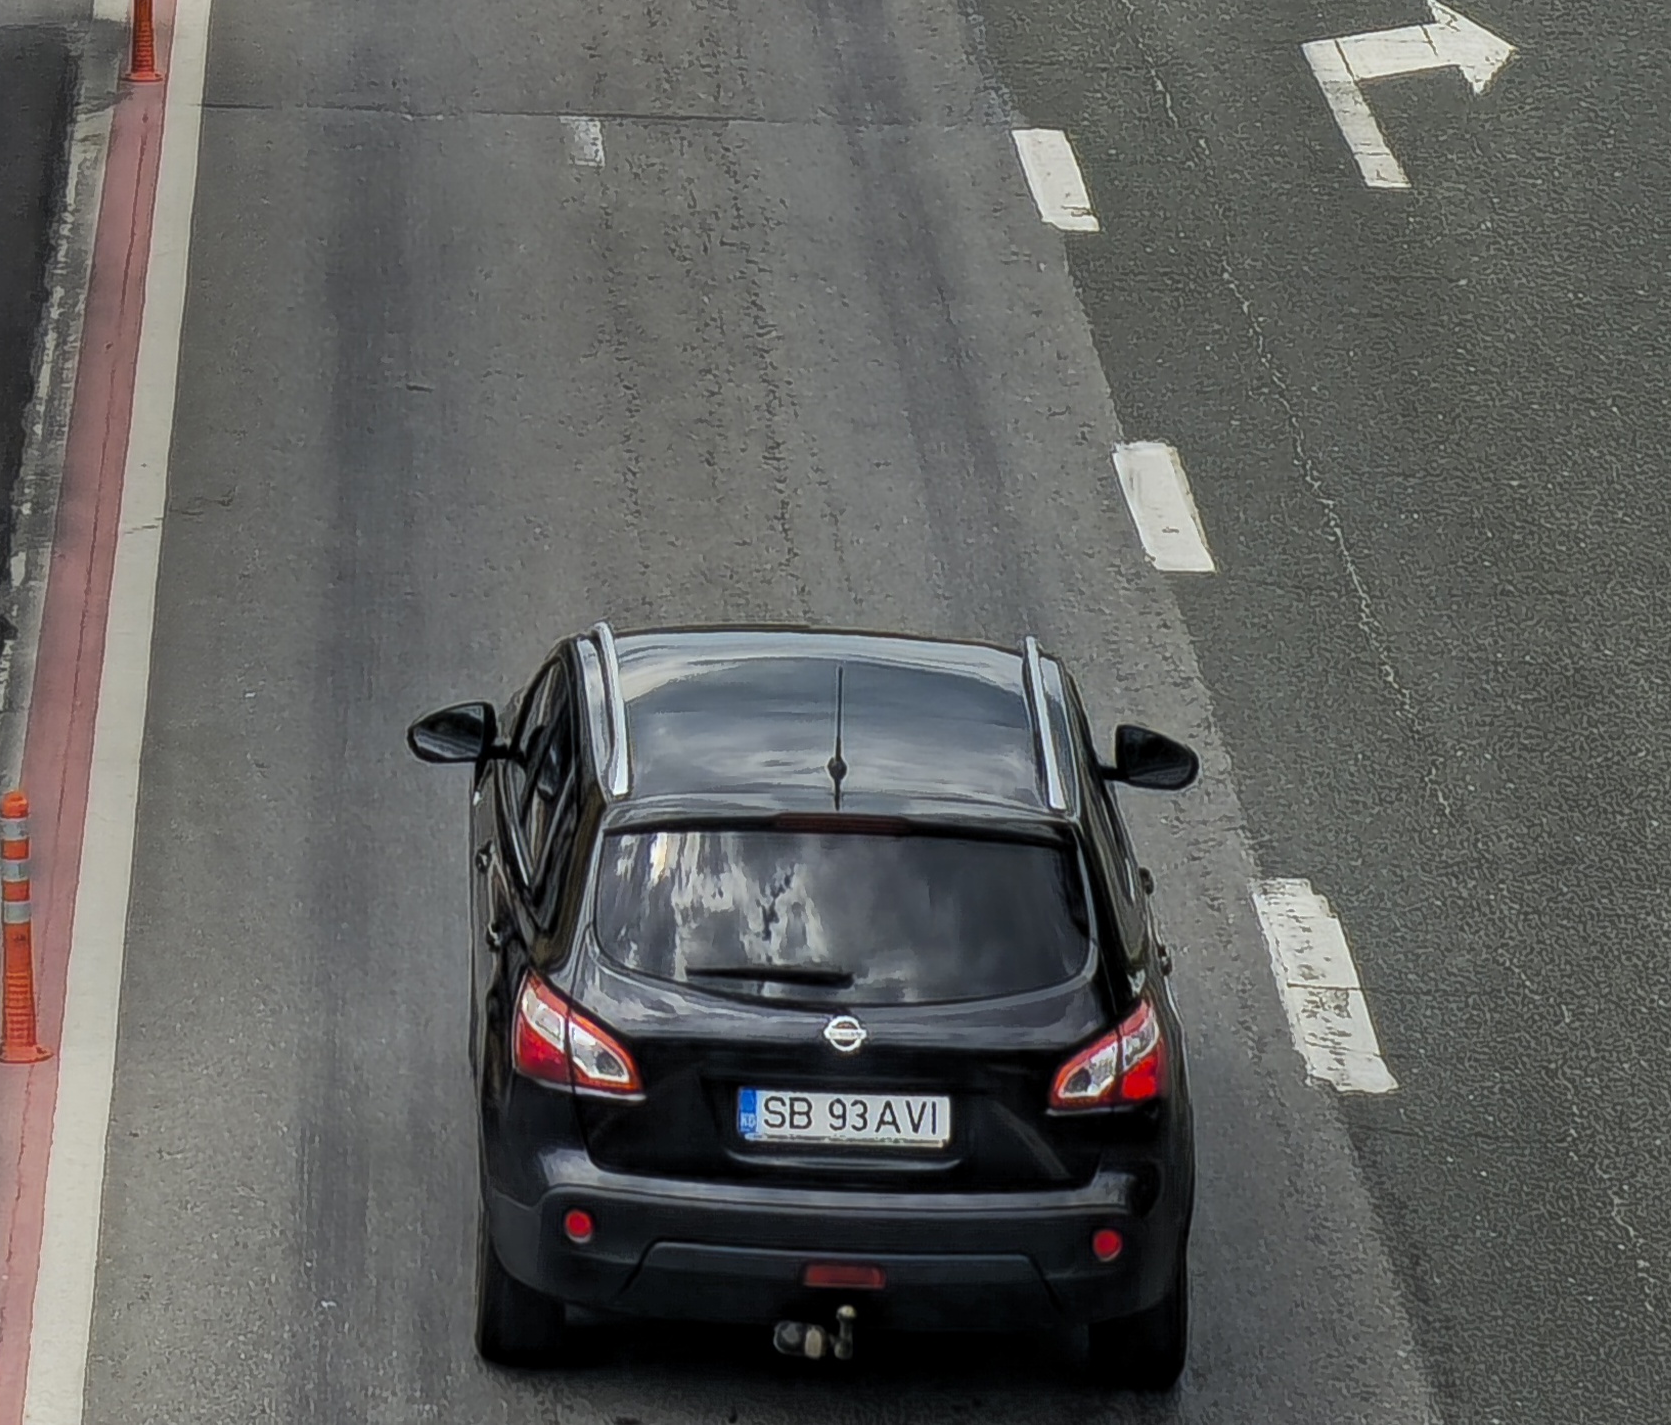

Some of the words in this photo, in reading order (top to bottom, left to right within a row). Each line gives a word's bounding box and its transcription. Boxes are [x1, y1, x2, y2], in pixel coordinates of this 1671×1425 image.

[763, 1096, 813, 1130] SB
[828, 1098, 868, 1132] 93
[875, 1100, 938, 1135] AVI
